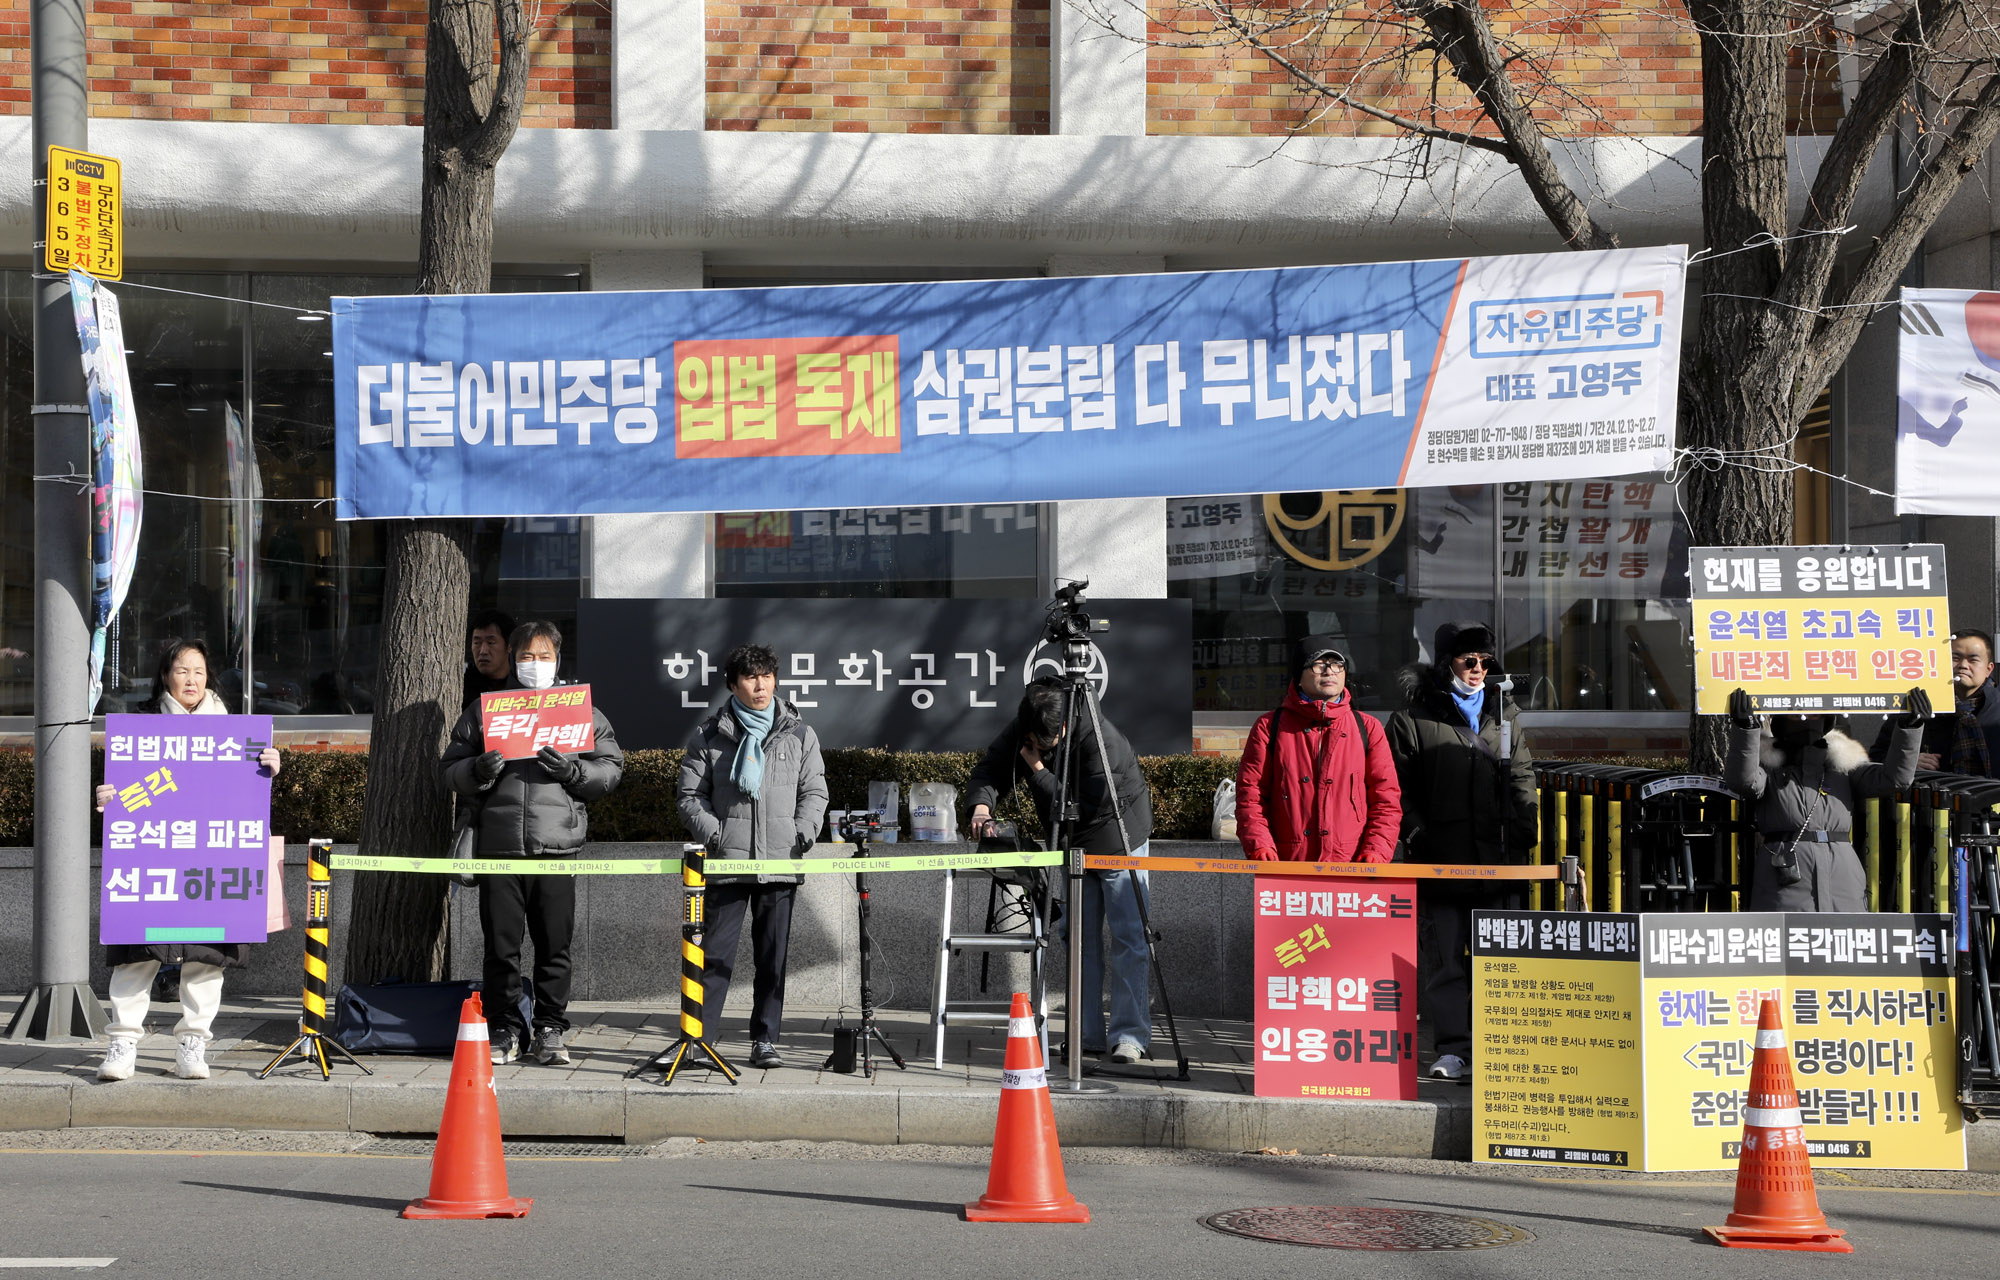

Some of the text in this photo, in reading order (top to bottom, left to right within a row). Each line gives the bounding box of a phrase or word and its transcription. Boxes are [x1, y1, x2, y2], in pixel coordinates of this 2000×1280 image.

[77, 162, 103, 176] CCTV
[75, 180, 92, 268] 불법주정차
[97, 185, 114, 272] 무인단속구간
[1486, 305, 1648, 344] 자유민주당
[357, 330, 1411, 448] 더불어민주당 입법 독재 삼권분립 다 무너졌다
[1485, 361, 1642, 402] 대표 고영주
[1481, 426, 1527, 443] 02-717-1948
[1535, 425, 1550, 440] 정당
[1552, 422, 1582, 438] 직접설치
[1590, 421, 1605, 436] 기간
[1428, 434, 1667, 464] 본 현수막을 훼손 및 철거시 정당법 제37조에 의거 처벌 받을 수 있습니다.
[1703, 556, 1932, 592] 헌재를 응원합니다
[1708, 608, 1935, 640] 윤석열 초고속 킥!
[1711, 649, 1937, 681] 내란죄 탄핵 인용!
[663, 649, 1006, 711] 한문화공간
[485, 690, 586, 713] 내란수괴 윤석열
[1763, 696, 1886, 708] 세월호 사람들 리멤버 0416
[487, 713, 539, 739] 즉각
[532, 723, 591, 751] 탄핵!
[110, 735, 267, 762] 헌법재판소는
[118, 766, 178, 813] 즉각
[108, 820, 264, 849] 윤석열 파면
[452, 862, 487, 870] POLICE
[538, 863, 614, 871] 이 선을 넘지마시오!
[720, 863, 765, 871] 넘지마시오!
[832, 861, 891, 869] POLICE LINE
[917, 856, 993, 867] 이 선을 넘지마시오!
[1330, 865, 1357, 873] POLICE
[105, 867, 264, 903] 선고하라!
[1260, 890, 1412, 918] 헌법재판소는
[1274, 923, 1331, 969] 즉각
[1478, 918, 1636, 953] 반박불가 윤석열 내란죄!
[1484, 962, 1520, 974] 윤석열은,
[1267, 976, 1402, 1012] 탄핵안을
[1484, 978, 1594, 992] 계엄을 발령할 상황도 아닌데
[1484, 1005, 1632, 1021] 국무회의 심의절차도 제대로 안지킨 채
[1658, 990, 1731, 1027] 헌재는
[1827, 989, 1947, 1026] 직시하라!
[1261, 1027, 1412, 1064] 인용하라!
[1484, 1034, 1635, 1050] 국법상 행위에 대한 문서나 부서도 없이
[1484, 1062, 1578, 1076] 국회에 대한 통고도 없이
[1794, 1038, 1914, 1076] 명령이다!
[1301, 1085, 1371, 1097] 전국비상시국회의
[1484, 1090, 1630, 1107] 헌법기관에 병력을 투입해서 실력으로
[1484, 1103, 1518, 1113] 봉쇄하고
[1522, 1104, 1565, 1116] 권능행사를
[1568, 1107, 1594, 1118] 방해한
[1484, 1119, 1571, 1134] 우두머리(수괴)입니다.
[1505, 1147, 1610, 1162] 세월호 사람들 리멤버 0416
[1828, 1143, 1850, 1155] 0416
